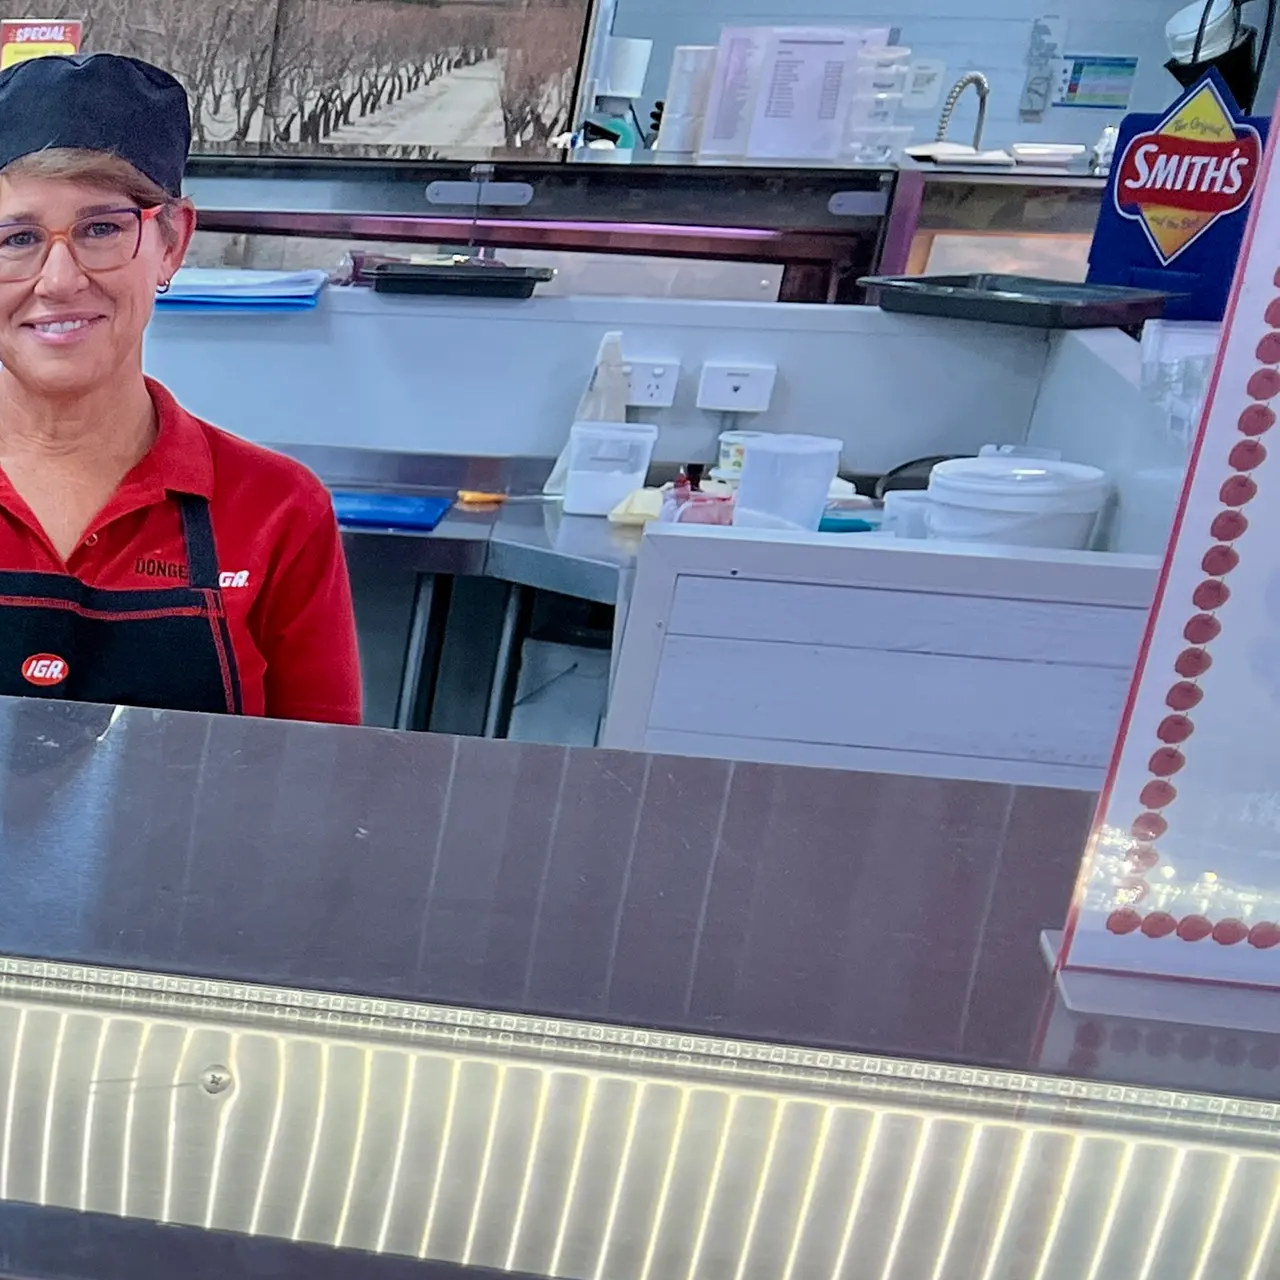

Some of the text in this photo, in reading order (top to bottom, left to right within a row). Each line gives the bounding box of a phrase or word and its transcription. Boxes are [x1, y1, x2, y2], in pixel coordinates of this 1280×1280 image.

[16, 26, 65, 41] SPECIAL
[1124, 144, 1249, 194] SMITH'S
[135, 557, 250, 587] DONGE GA
[26, 660, 64, 679] IGA
